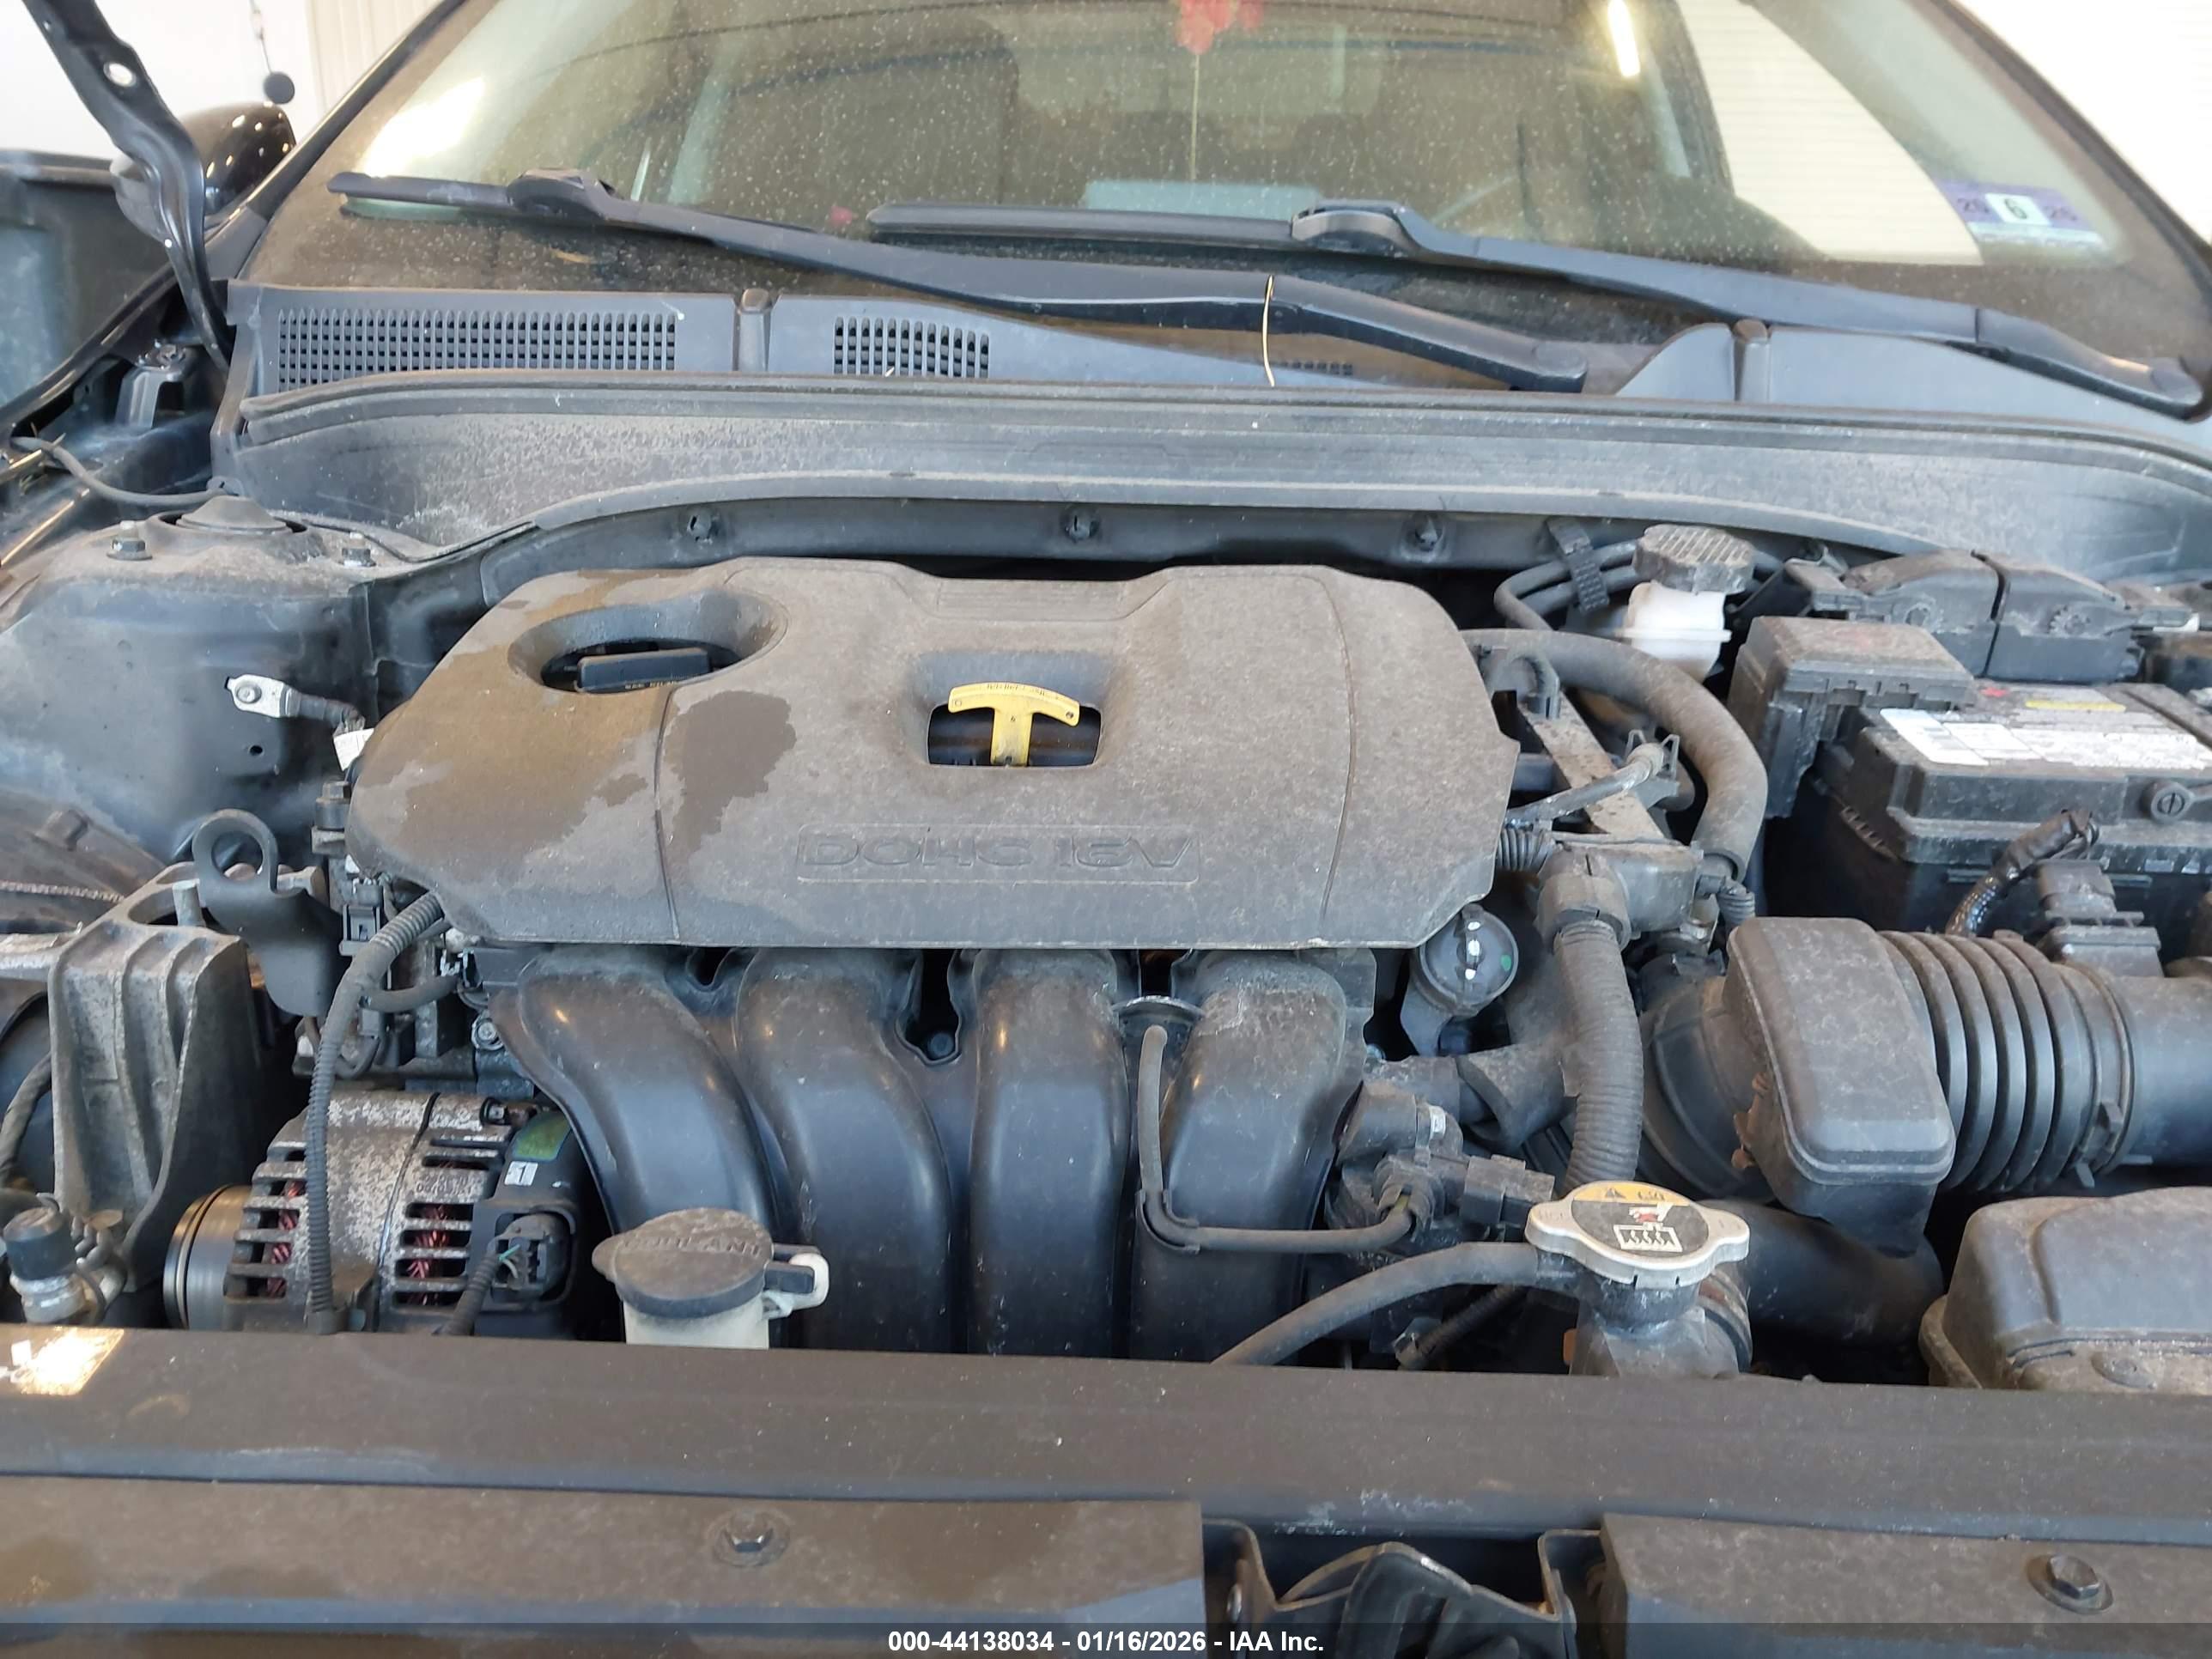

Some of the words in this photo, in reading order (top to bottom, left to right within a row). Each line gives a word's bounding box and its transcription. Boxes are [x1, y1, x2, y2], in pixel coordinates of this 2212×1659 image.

[2003, 198, 2028, 220] 6
[802, 835, 1032, 868] DOHC
[1054, 835, 1194, 869] 16V
[515, 1161, 527, 1183] 1
